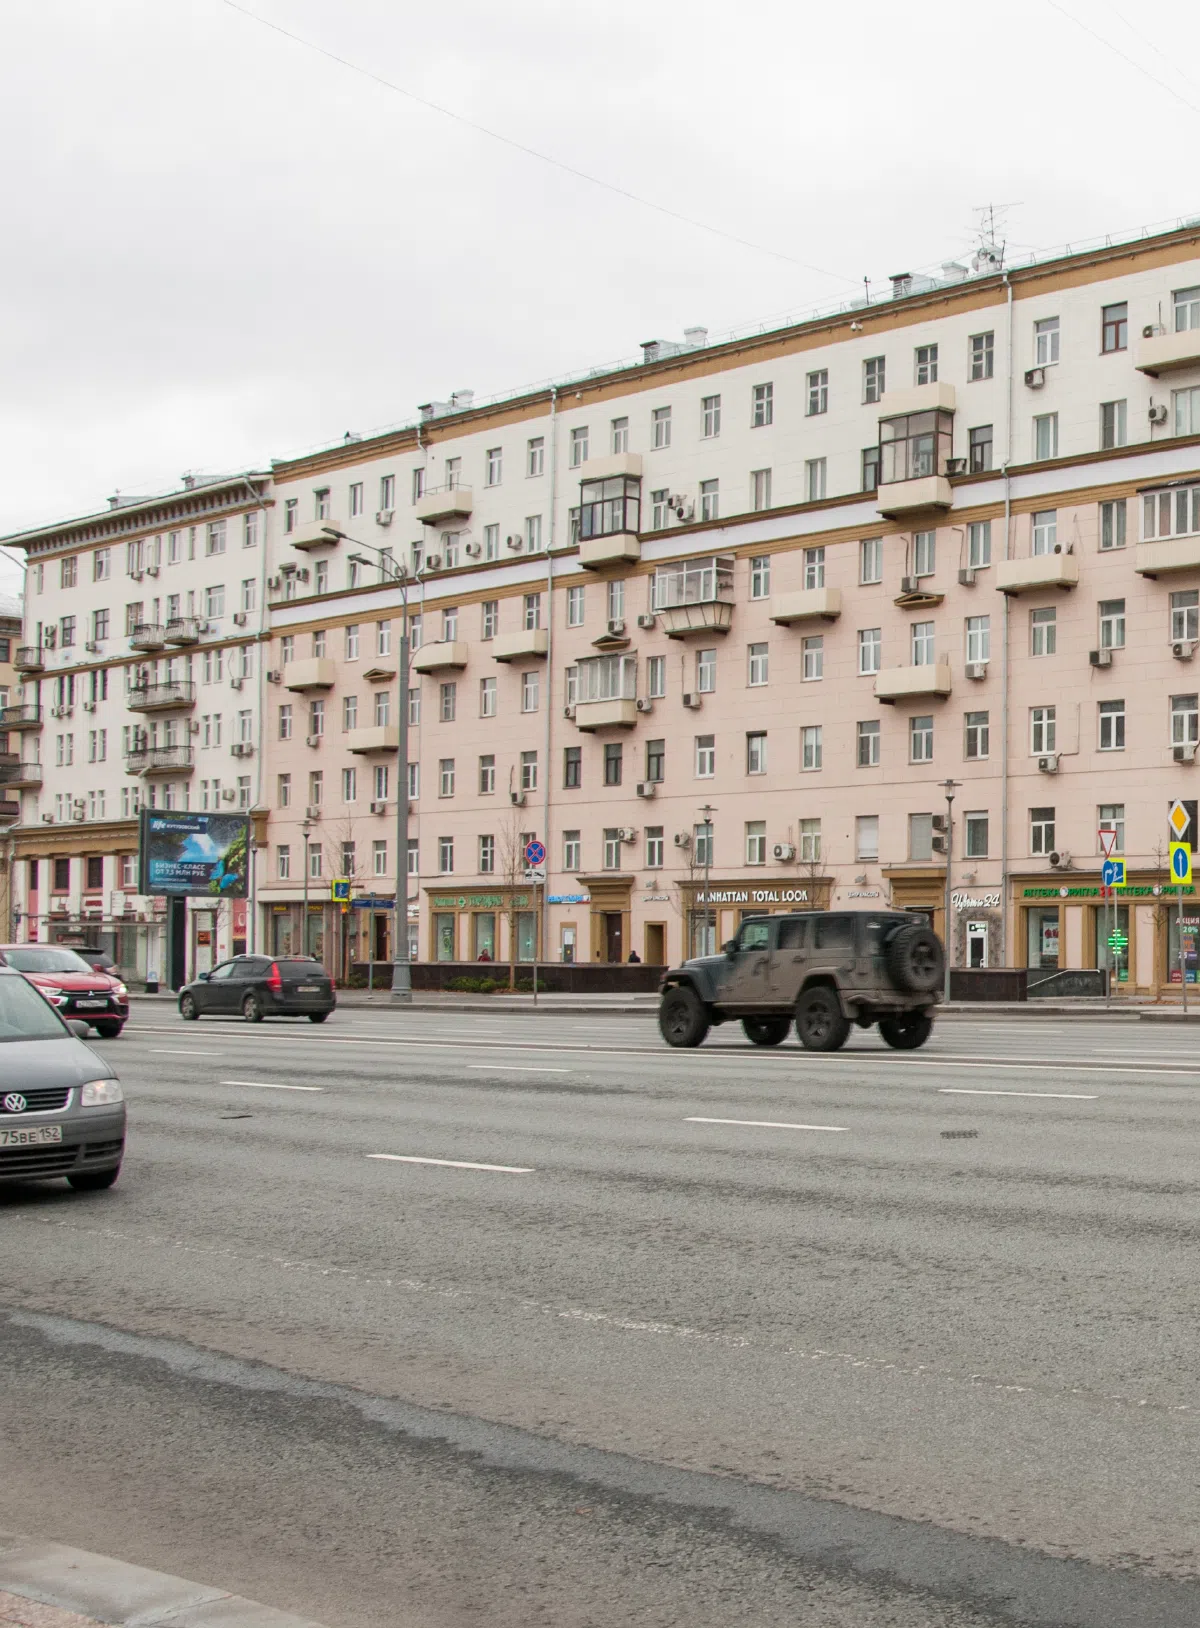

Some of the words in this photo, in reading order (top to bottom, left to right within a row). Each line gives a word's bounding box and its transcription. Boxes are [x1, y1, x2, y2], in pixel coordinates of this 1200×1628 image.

[152, 820, 166, 830] life
[696, 892, 748, 902] MNHATTAN
[752, 890, 780, 902] TOTAL
[782, 890, 808, 902] LOOK
[1024, 888, 1060, 898] АПТЕКА
[984, 894, 1000, 908] 24
